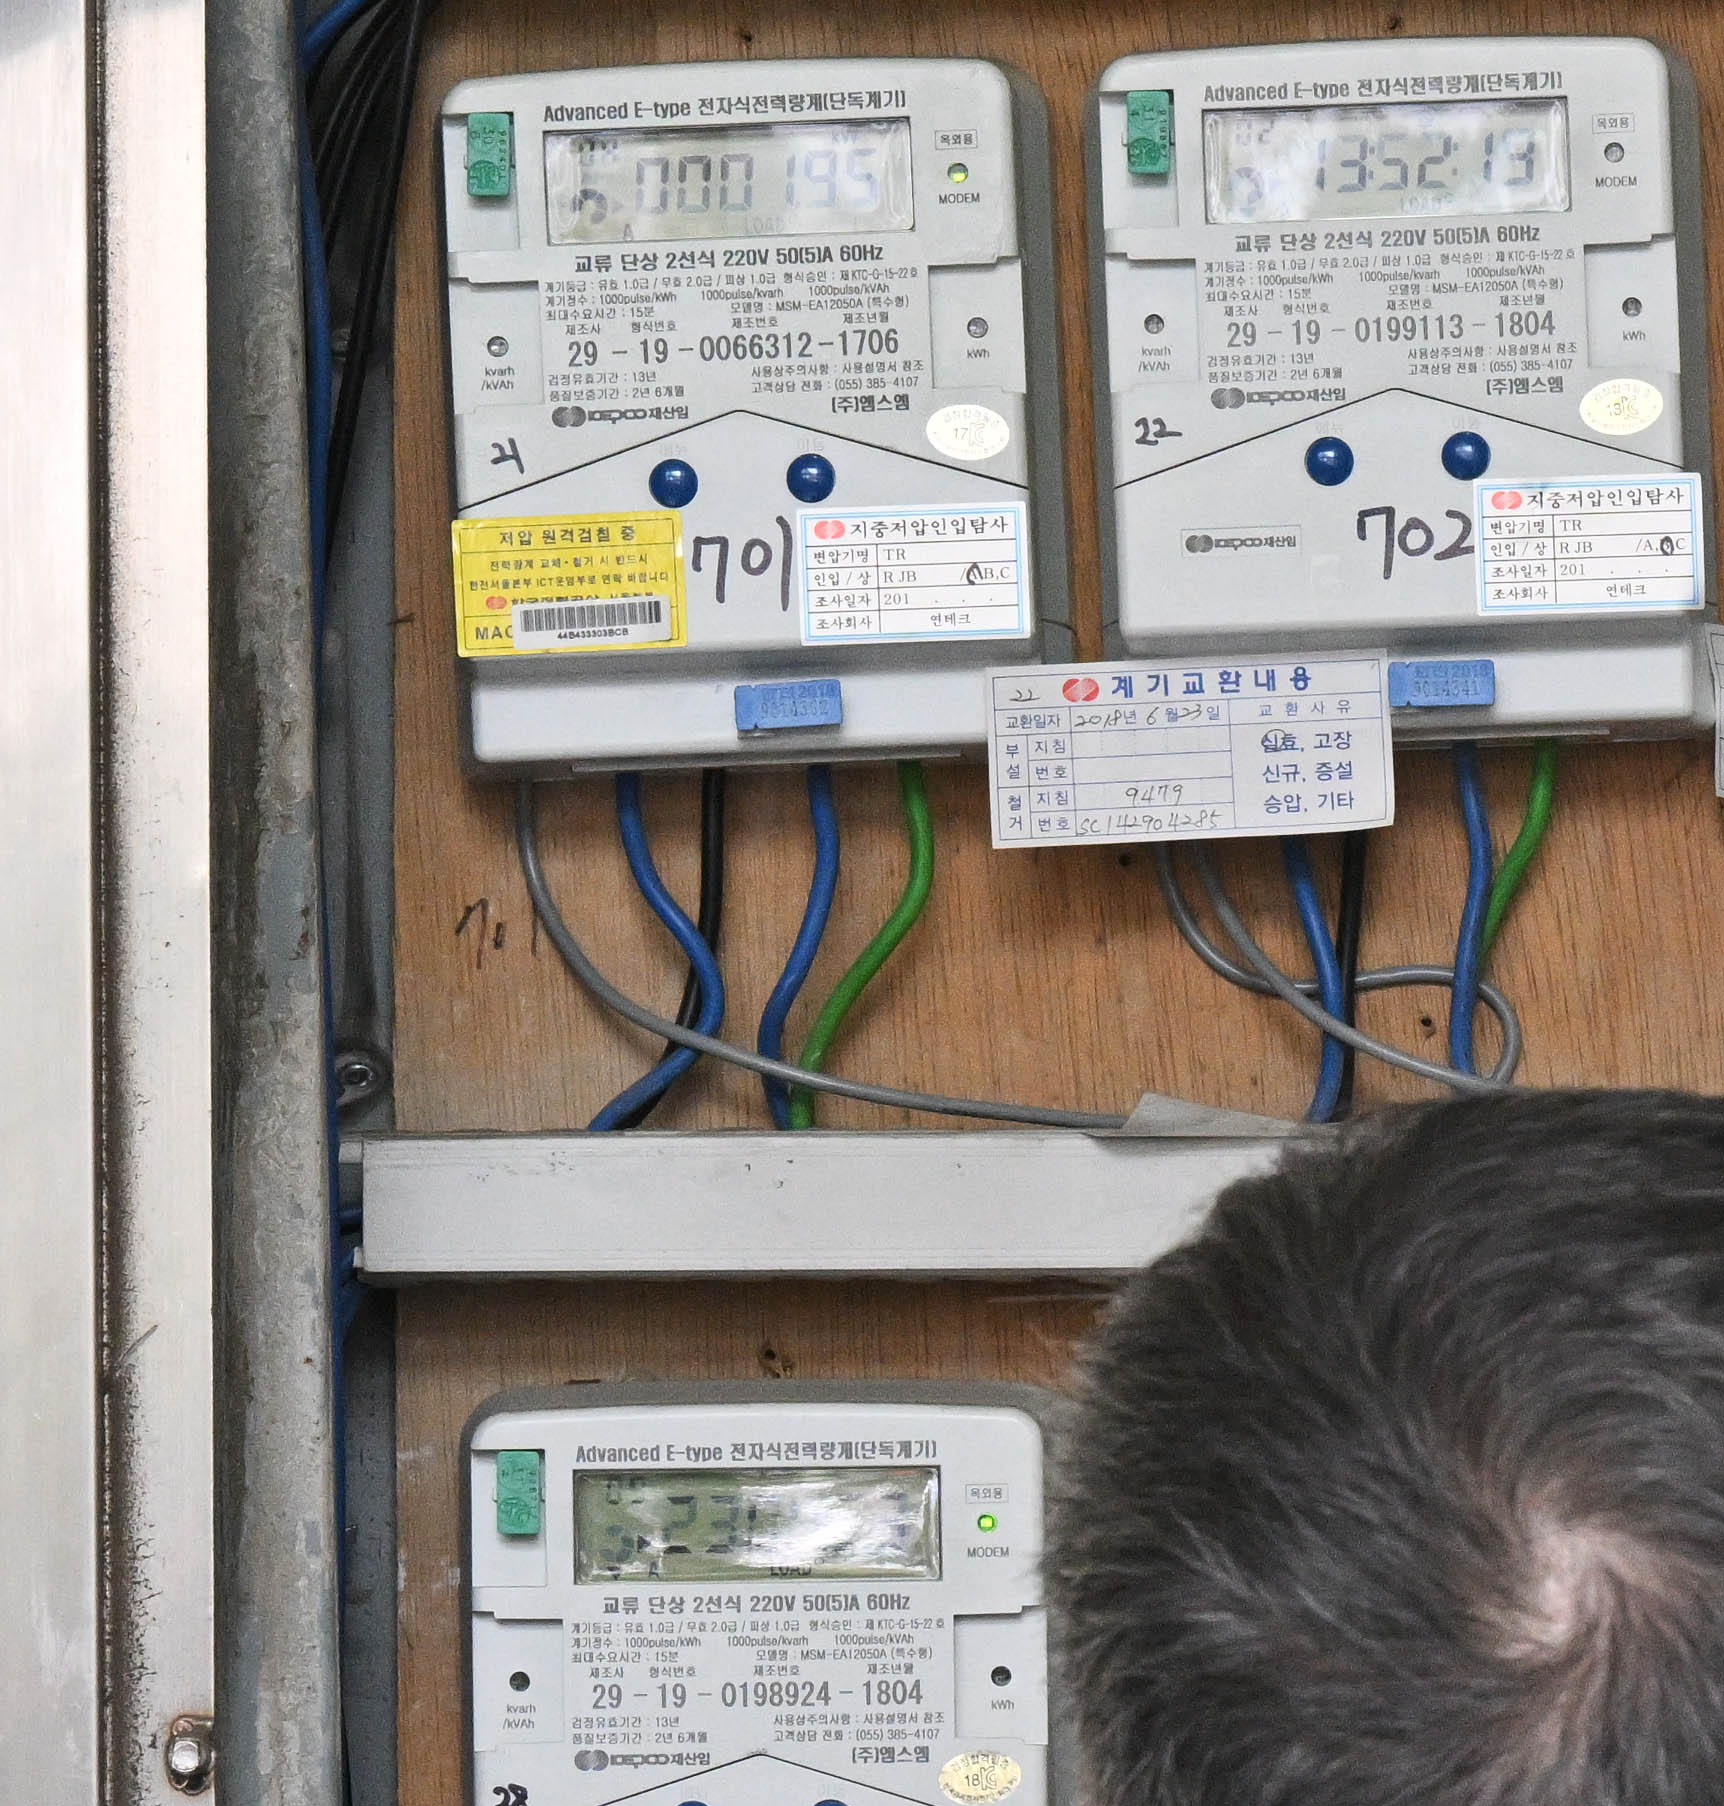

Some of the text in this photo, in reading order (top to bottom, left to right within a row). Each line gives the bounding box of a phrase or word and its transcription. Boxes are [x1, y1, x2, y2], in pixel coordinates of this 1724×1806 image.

[1204, 83, 1288, 102] Advanced
[1294, 80, 1349, 100] E-type
[575, 254, 613, 274] 교류
[621, 252, 659, 272] 단상
[666, 250, 715, 269] 2선식
[723, 248, 769, 266] 220V
[841, 243, 885, 261] 60Hz
[1354, 313, 1464, 343] 0199113
[568, 328, 899, 368] 29 19 0066312 1706
[1357, 507, 1475, 579] 702
[692, 515, 792, 611] 701
[1005, 713, 1062, 730] 교환일자
[1314, 728, 1354, 752] 고장
[1315, 760, 1355, 784] 증설
[1036, 789, 1070, 806] 지침
[1317, 789, 1356, 812] 기타
[1038, 815, 1070, 832] 번호
[576, 1445, 660, 1462] Advanced
[666, 1444, 722, 1462] E-type
[592, 1679, 923, 1709] 29 19 0198924 1804
